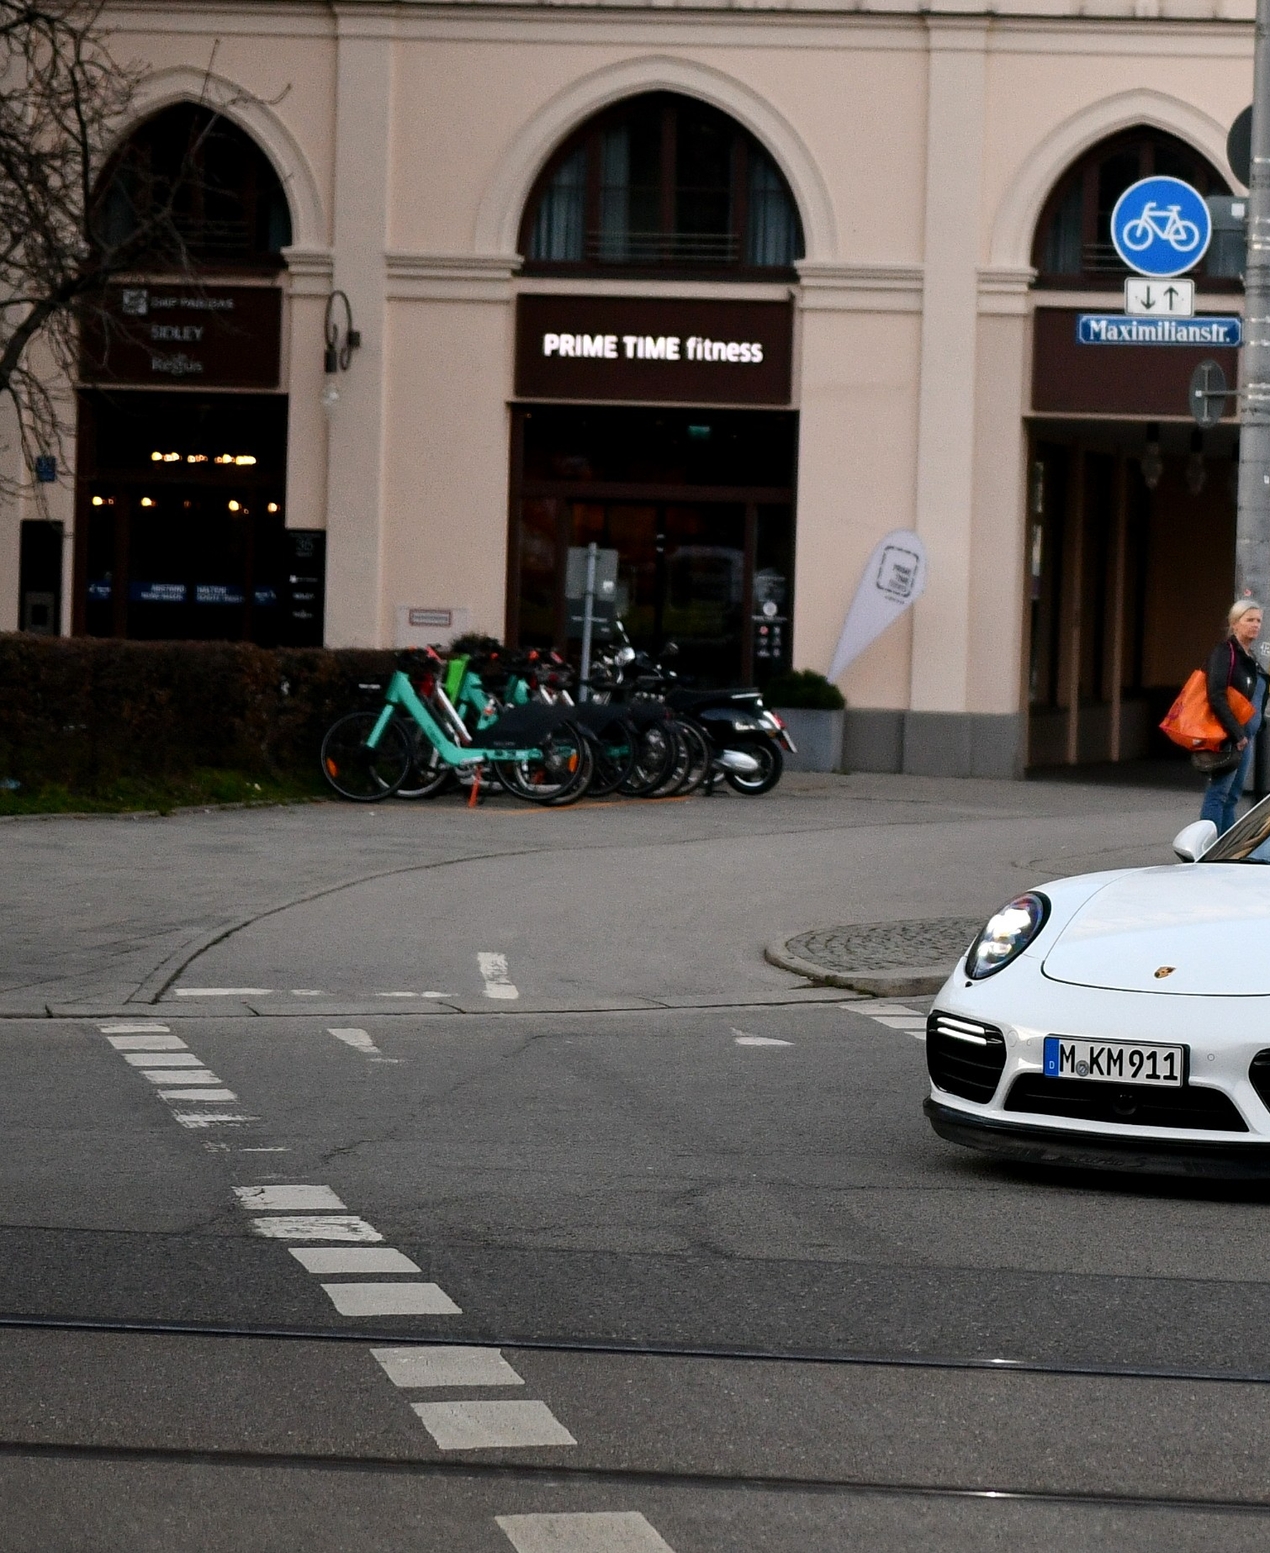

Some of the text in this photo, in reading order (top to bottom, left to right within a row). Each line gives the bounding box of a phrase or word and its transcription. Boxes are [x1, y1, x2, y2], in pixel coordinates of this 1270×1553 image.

[1089, 319, 1231, 343] Maximilianstr.
[543, 333, 764, 363] PRIME TIME fitness
